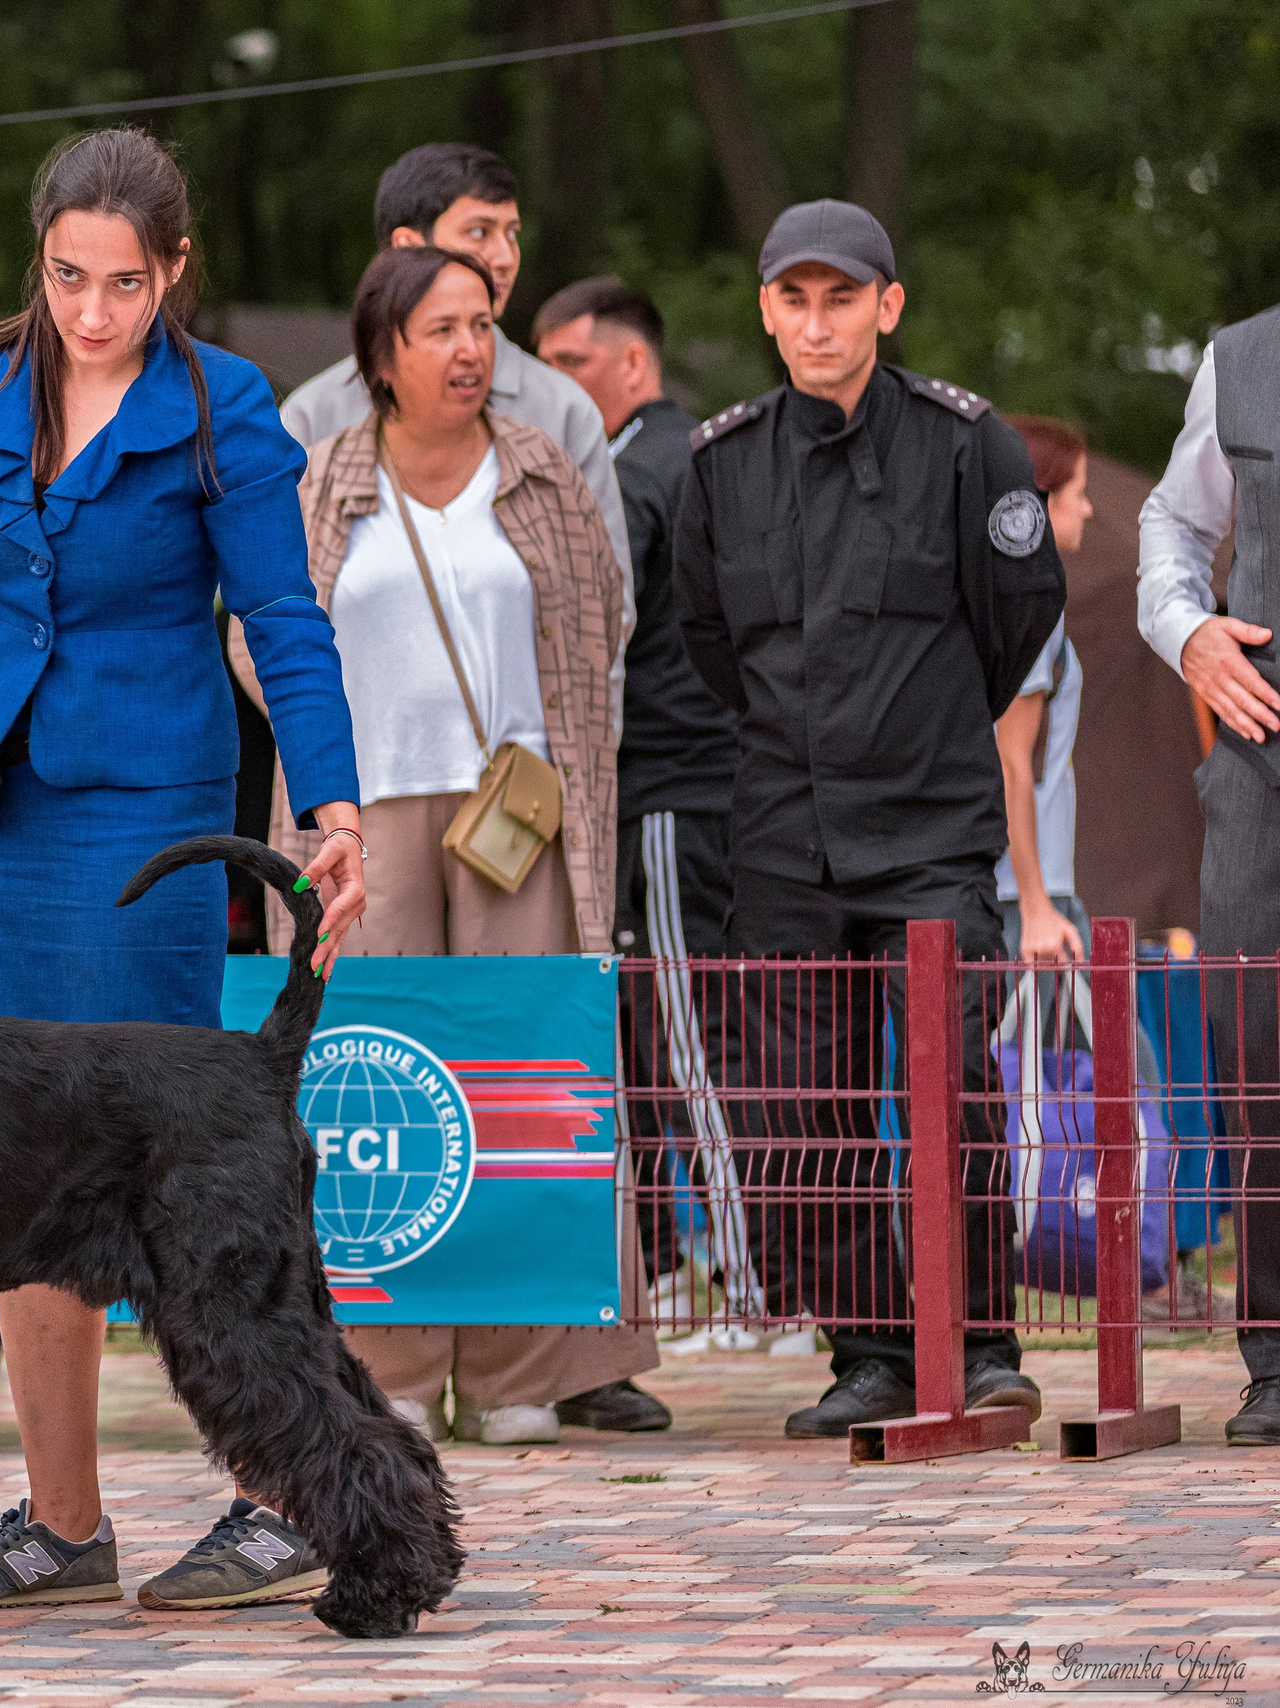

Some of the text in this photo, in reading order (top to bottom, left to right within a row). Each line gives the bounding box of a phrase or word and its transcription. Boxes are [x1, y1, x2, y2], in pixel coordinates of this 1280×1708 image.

[316, 1128, 399, 1171] FCI
[379, 1066, 463, 1257] INTERNATIONALE
[3, 1540, 60, 1585] N
[236, 1528, 295, 1571] N
